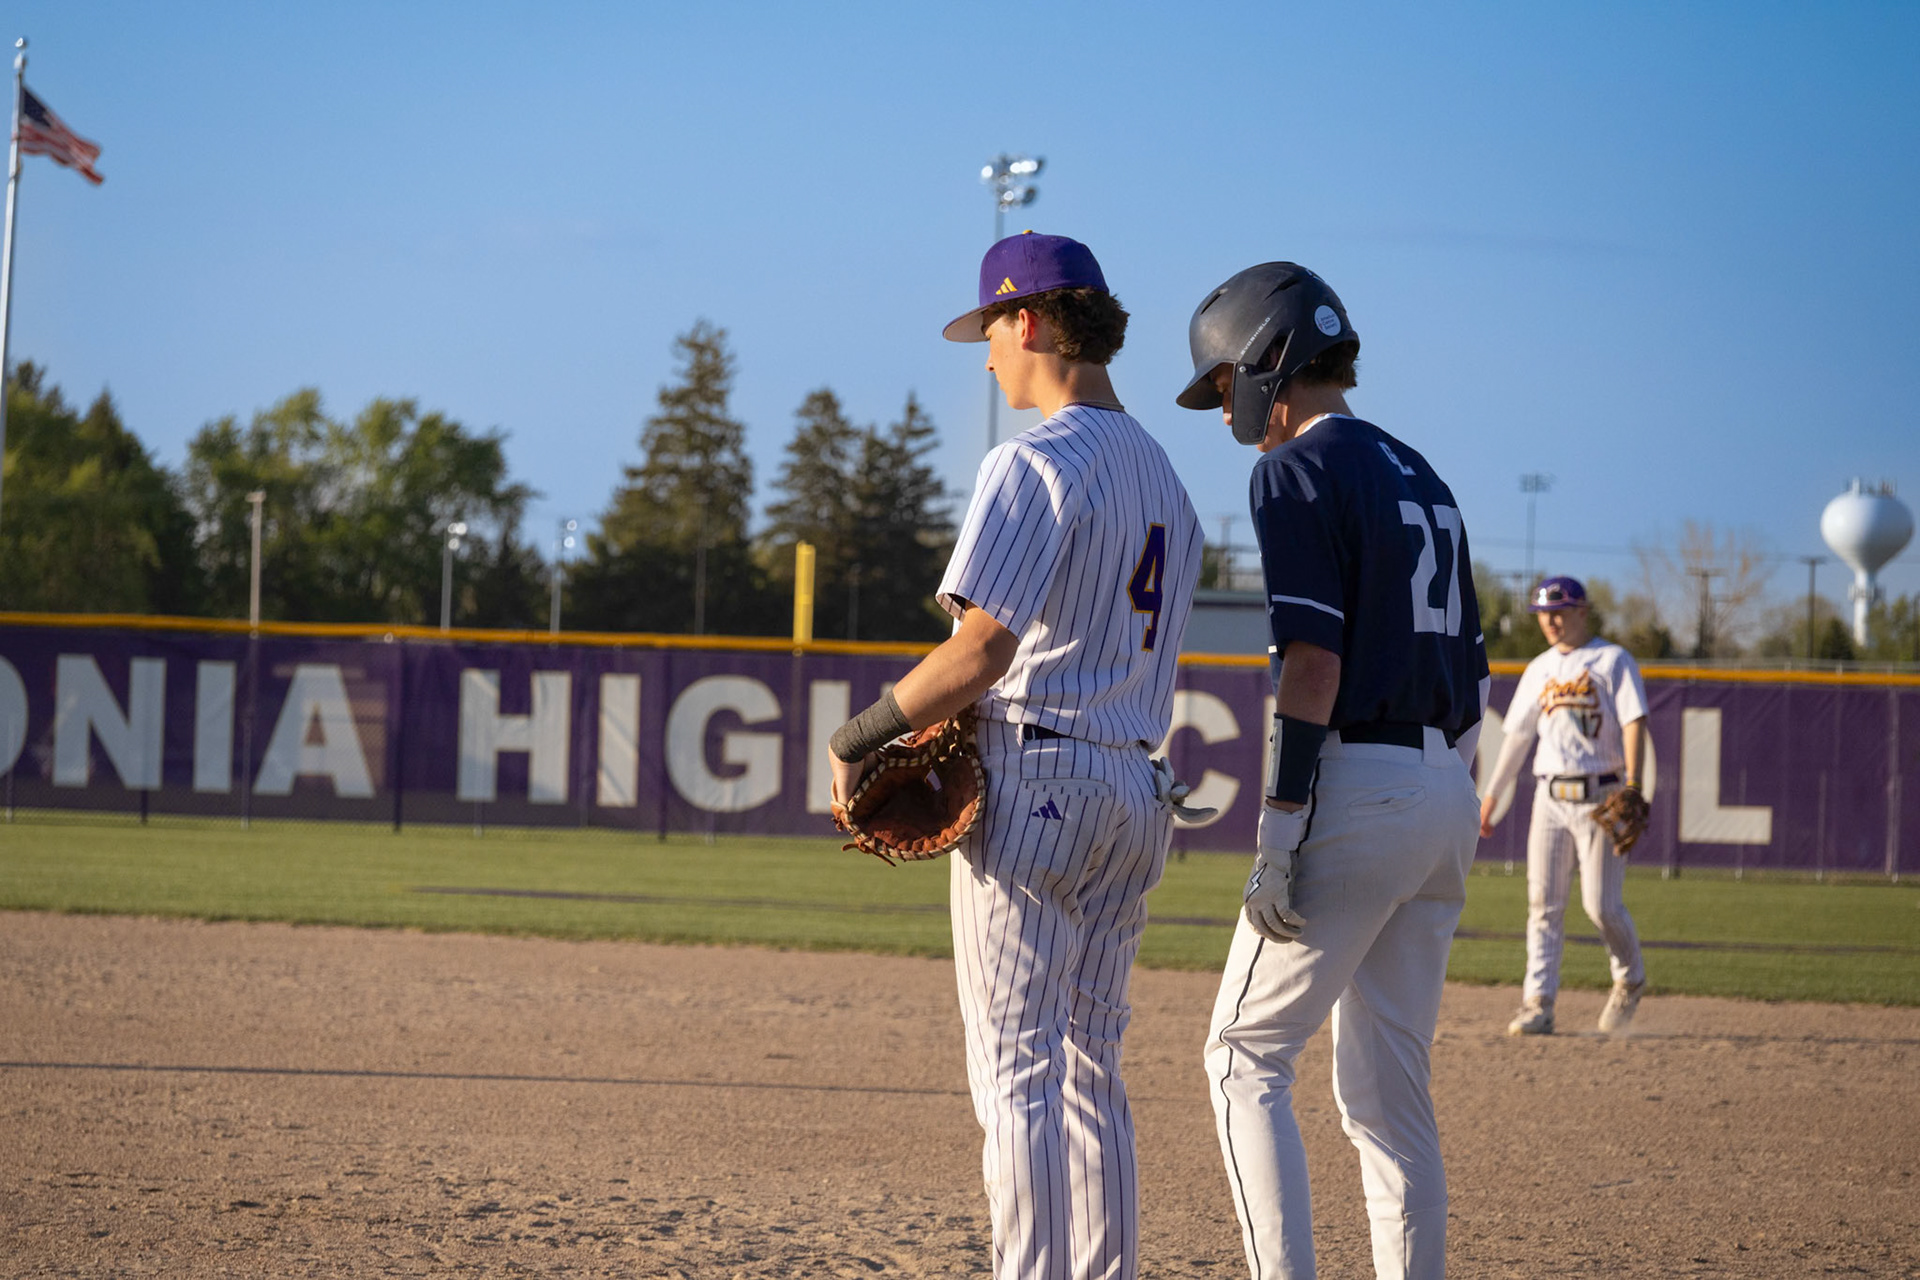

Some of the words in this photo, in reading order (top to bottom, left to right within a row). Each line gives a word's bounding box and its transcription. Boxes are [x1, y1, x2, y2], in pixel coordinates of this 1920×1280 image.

[1126, 522, 1166, 653] 4
[1398, 500, 1462, 637] 27
[0, 653, 375, 799] NIA
